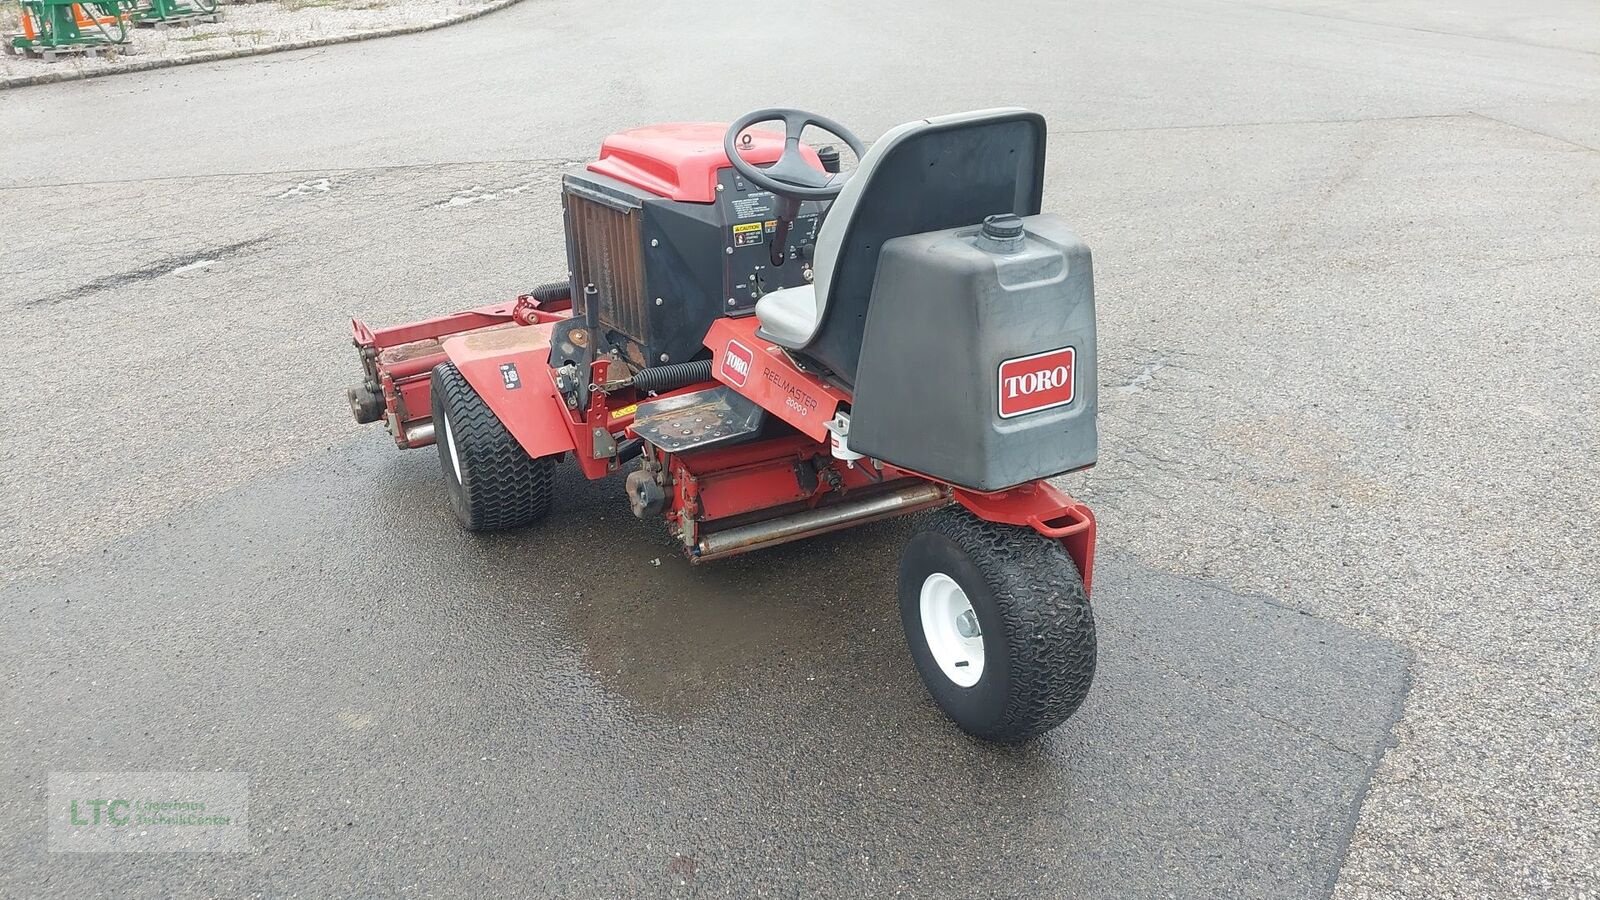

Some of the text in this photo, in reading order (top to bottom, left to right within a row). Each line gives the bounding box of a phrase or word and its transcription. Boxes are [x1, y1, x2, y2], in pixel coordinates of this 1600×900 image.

[726, 350, 748, 376] TORO
[762, 367, 818, 411] REELMASTER
[1004, 366, 1068, 398] TORO
